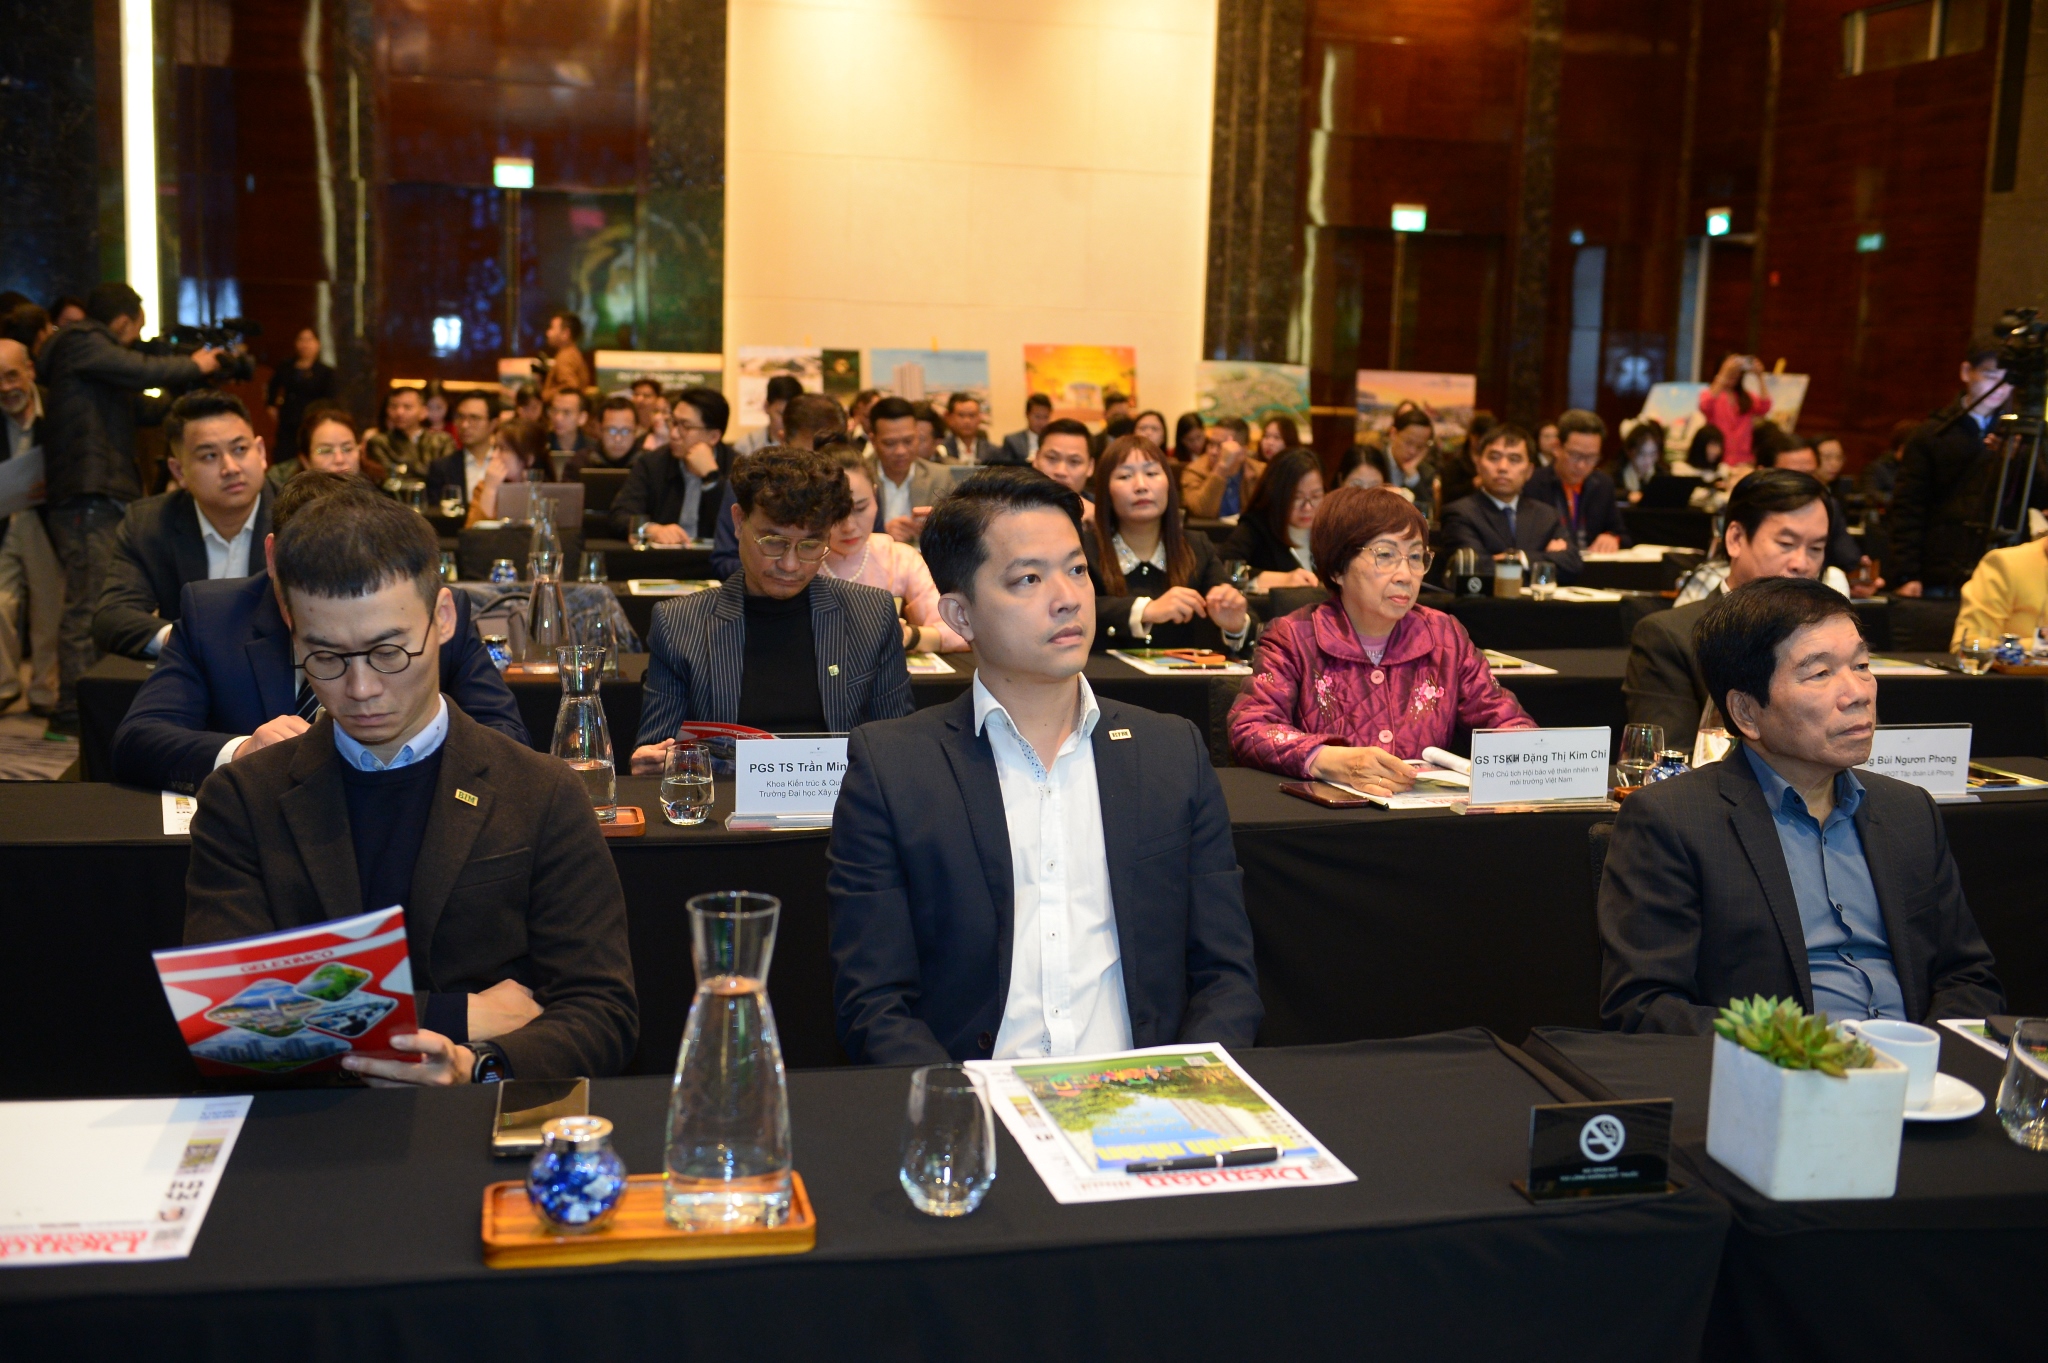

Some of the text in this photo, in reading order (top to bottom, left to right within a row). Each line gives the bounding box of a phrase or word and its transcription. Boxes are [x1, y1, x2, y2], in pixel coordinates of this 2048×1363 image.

[1474, 755, 1490, 765] GS
[1523, 752, 1548, 765] Đặng
[1551, 751, 1566, 762] Thị
[1569, 750, 1588, 760] Kim
[1590, 749, 1607, 759] Chi
[1877, 755, 1893, 765] Bùi
[1928, 754, 1958, 765] Phong
[749, 760, 847, 773] PGS TS Trần Min
[766, 780, 786, 788] Khoa
[787, 778, 804, 787] Kiến
[821, 779, 827, 787] &
[788, 789, 801, 798] Đại
[802, 789, 816, 798] học
[817, 789, 832, 798] Xây
[240, 949, 334, 973] GELEXIMCO
